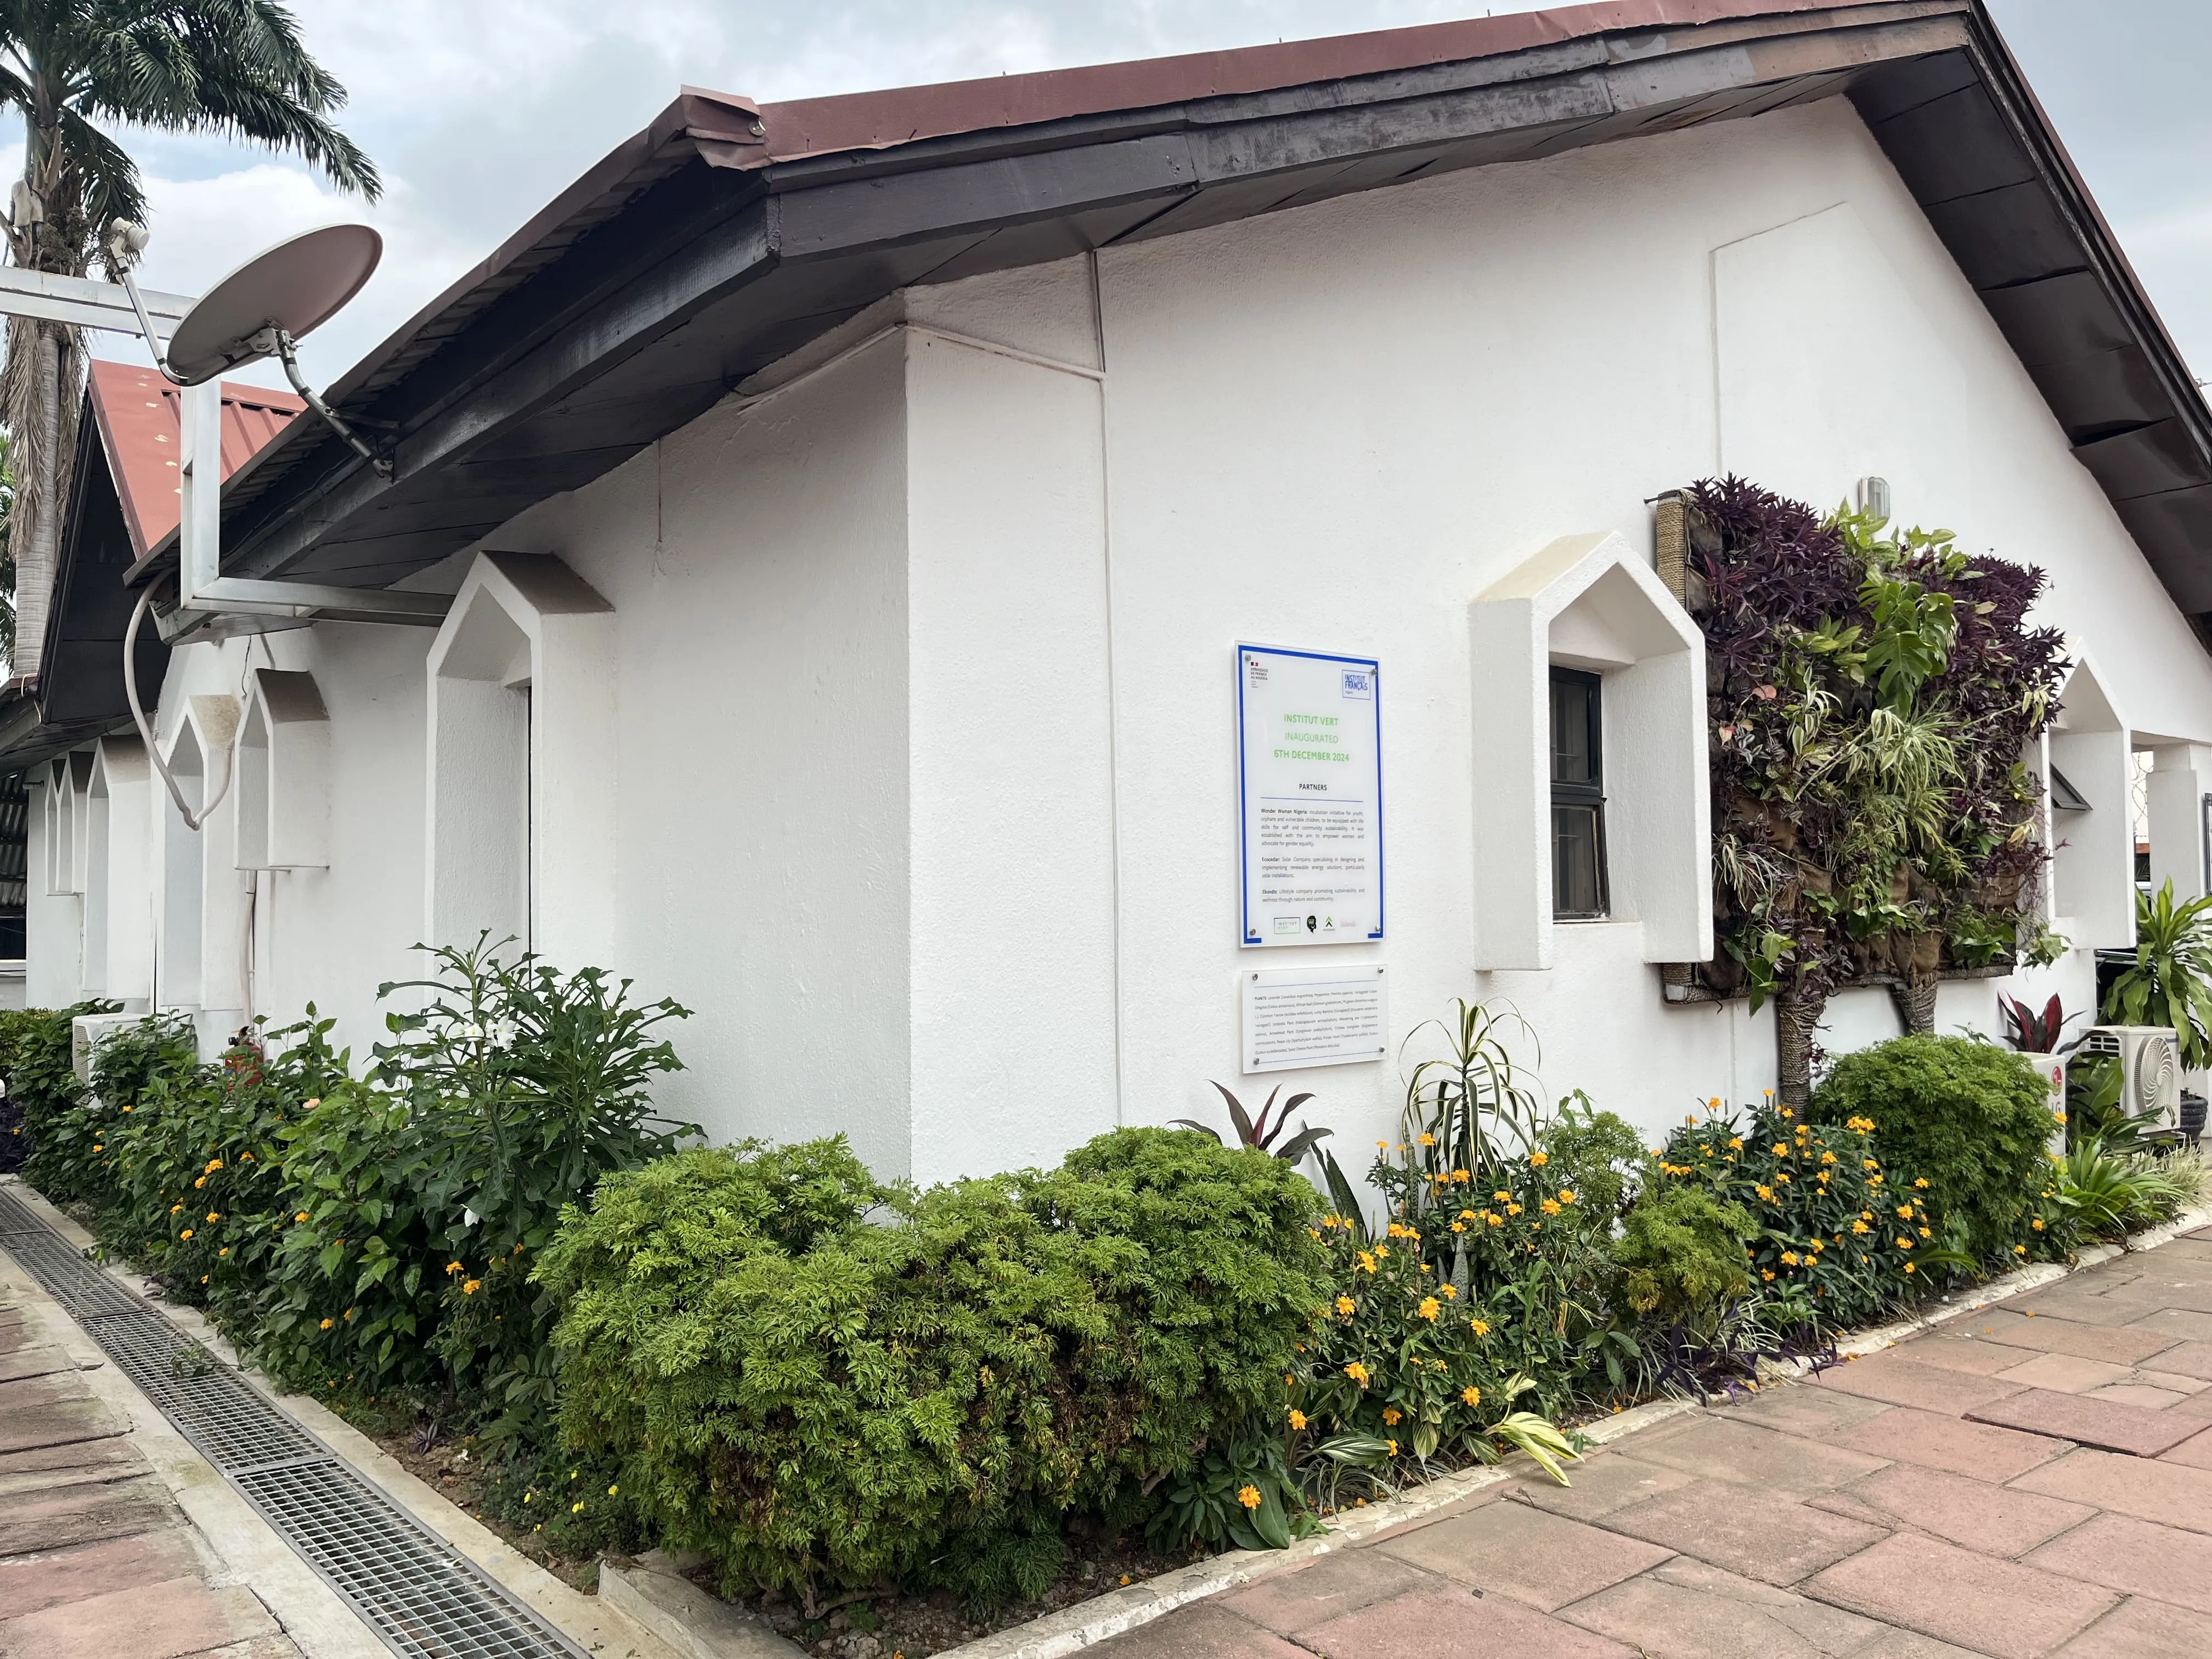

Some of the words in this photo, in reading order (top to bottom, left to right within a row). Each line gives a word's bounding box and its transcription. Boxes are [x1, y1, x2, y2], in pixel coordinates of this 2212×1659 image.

[1345, 674, 1365, 684] INSTITUT
[1345, 681, 1368, 691] FRANÇAIS
[1284, 714, 1318, 724] INSTITUT
[1320, 717, 1339, 726] VERT
[1285, 732, 1339, 743] INAUGURATED
[1274, 749, 1289, 758] 6TH
[1292, 751, 1331, 761] DECEMBER
[1333, 753, 1350, 761] 2024
